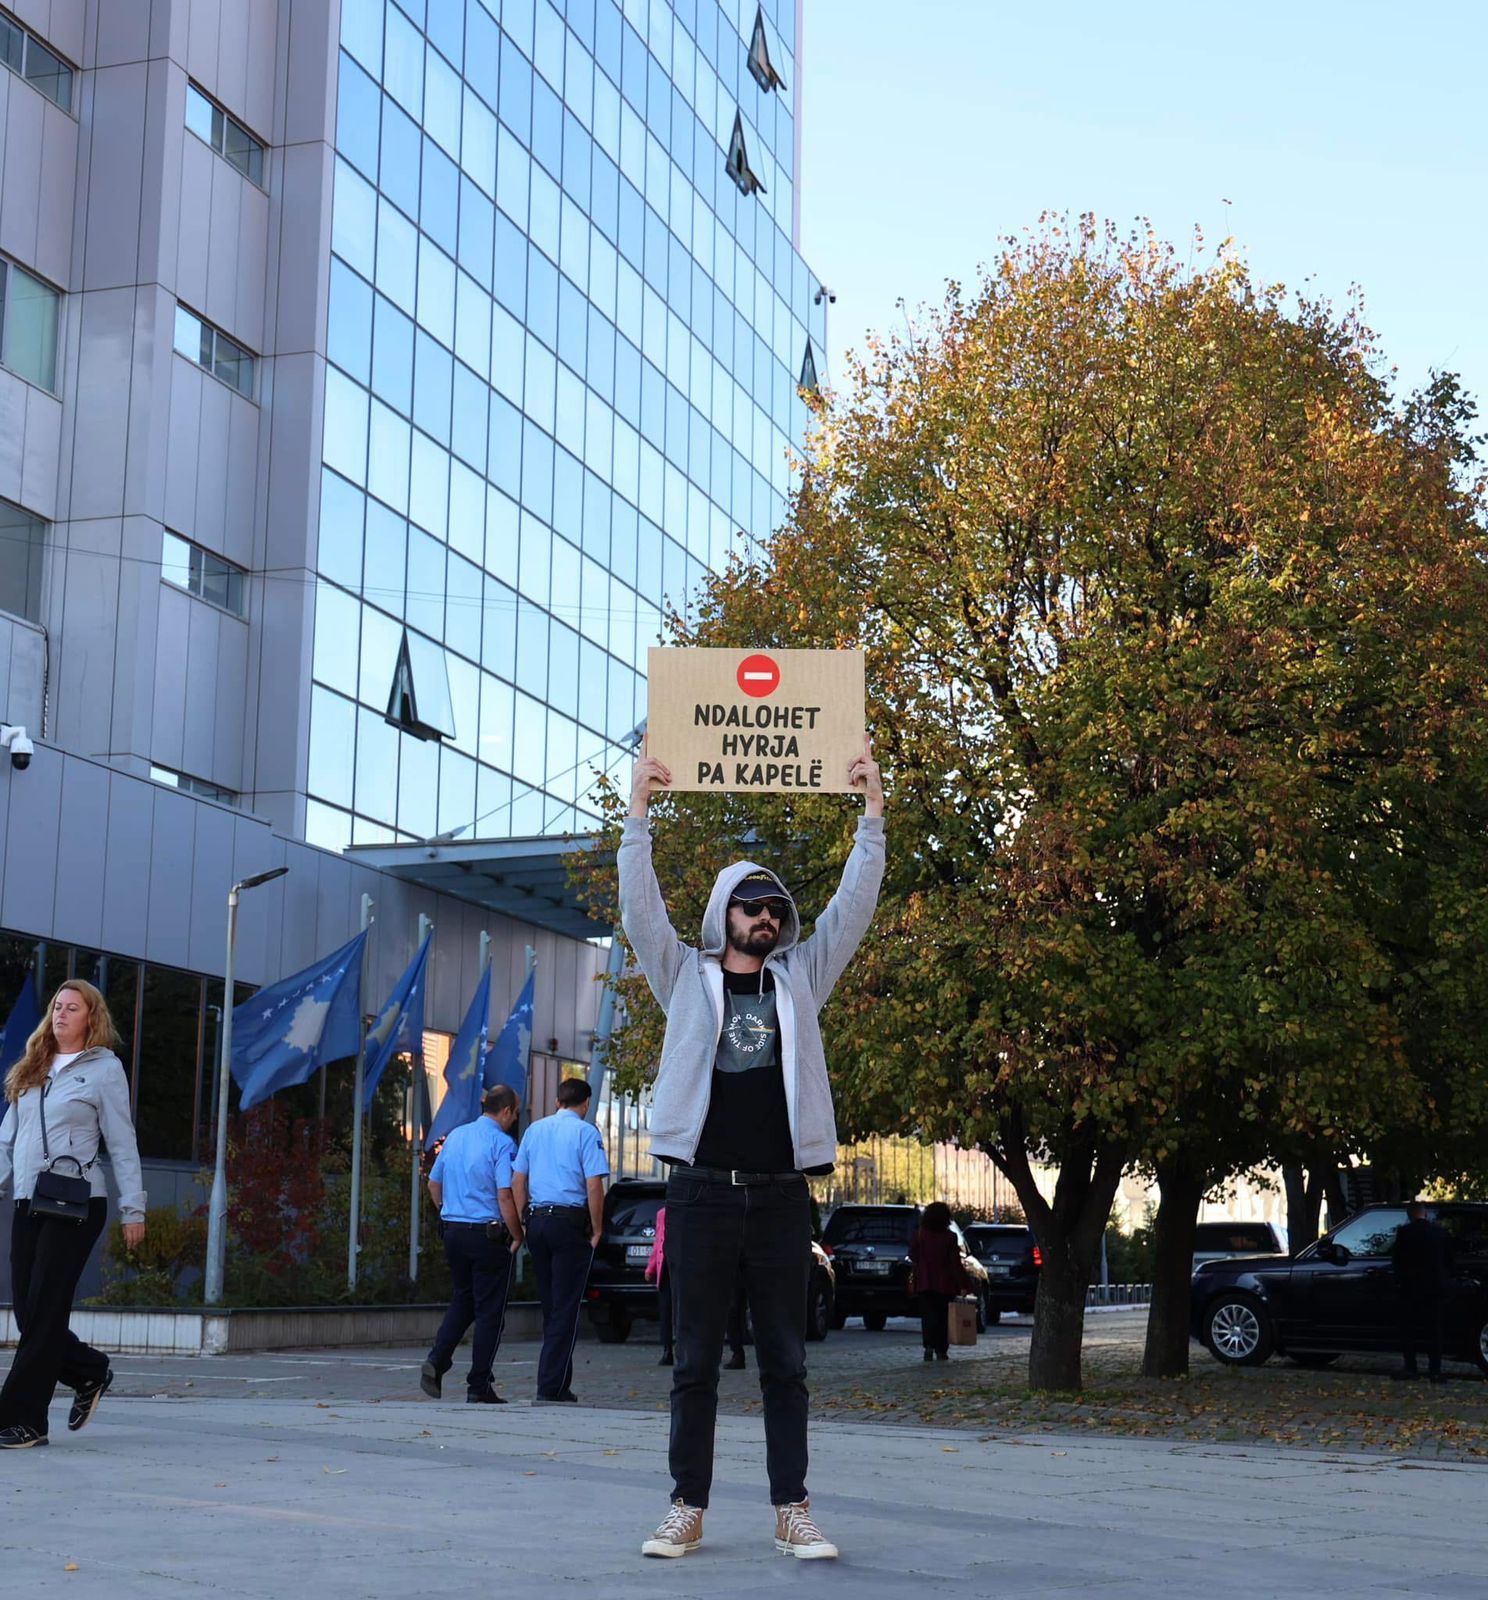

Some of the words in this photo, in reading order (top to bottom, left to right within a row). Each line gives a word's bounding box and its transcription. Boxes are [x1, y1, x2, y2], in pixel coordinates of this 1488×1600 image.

[694, 704, 821, 729] NDALOHET
[722, 734, 799, 758] HYRJA
[698, 761, 725, 785] PA
[735, 759, 823, 787] KAPELË
[728, 1031, 741, 1048] THE
[755, 1033, 767, 1050] SIDE
